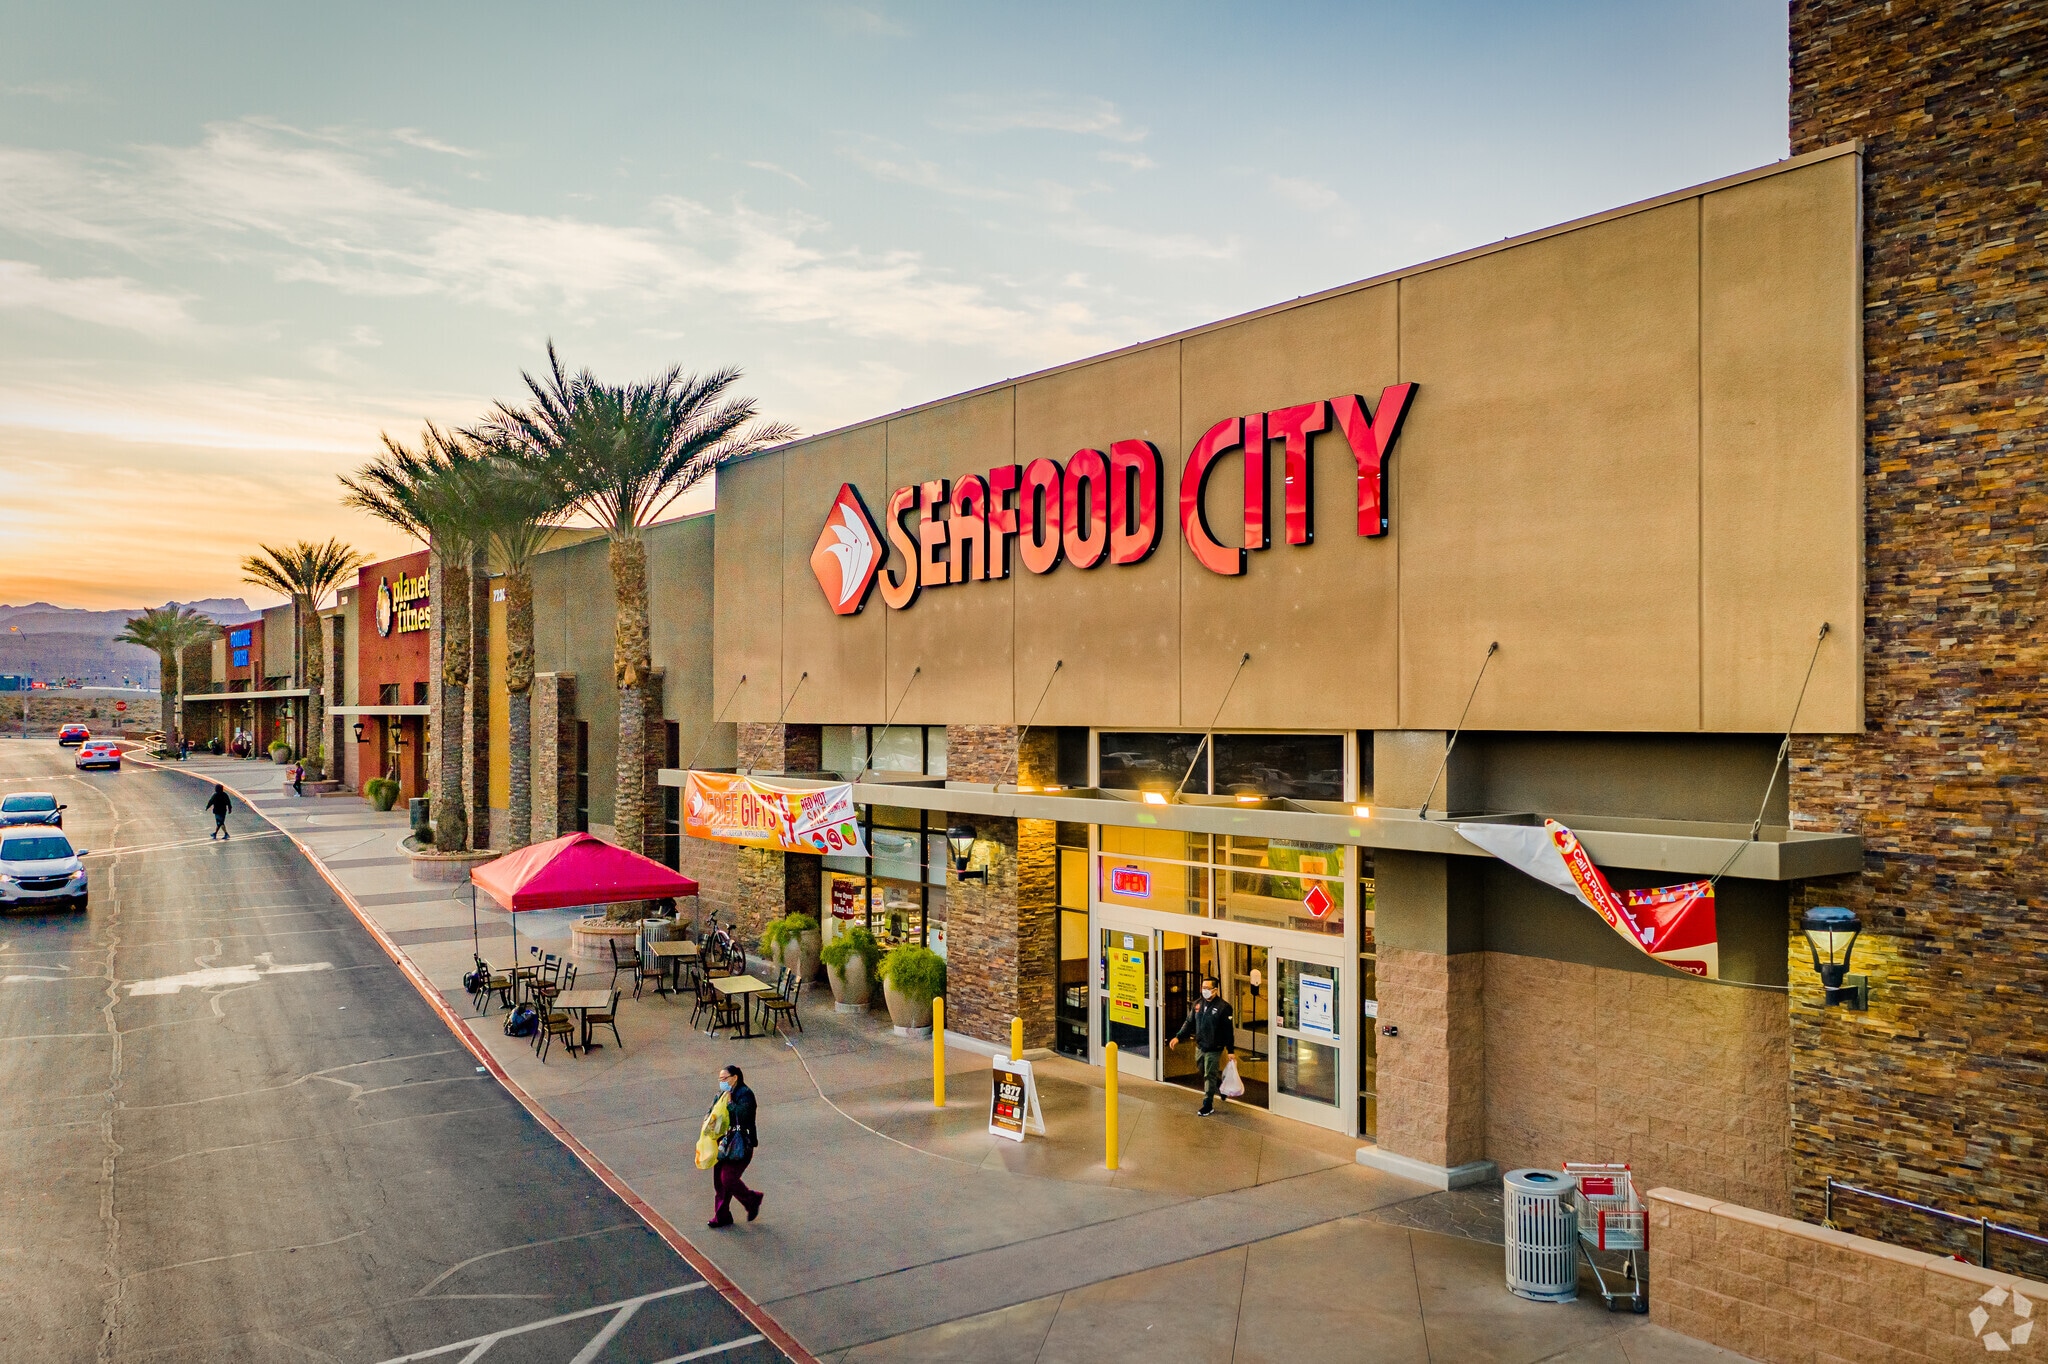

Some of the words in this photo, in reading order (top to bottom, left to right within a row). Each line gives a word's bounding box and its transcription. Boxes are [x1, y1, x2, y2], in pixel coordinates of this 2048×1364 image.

[878, 438, 1164, 610] SEAFOOD
[1179, 381, 1420, 576] CITY
[392, 567, 430, 612] planet
[397, 602, 431, 633] fitnes
[704, 791, 738, 827] FREE
[741, 793, 776, 829] GIFTS
[800, 797, 813, 811] RED
[813, 791, 827, 806] HOT
[806, 806, 828, 826] SALE
[1114, 871, 1147, 894] OPEN
[1569, 860, 1584, 884] (702)
[843, 892, 852, 900] Open
[1573, 849, 1588, 872] Call
[1584, 871, 1591, 882] &
[1589, 880, 1615, 923] Pick-up
[834, 904, 854, 915] Dine-In!
[1000, 1083, 1021, 1097] 1-877
